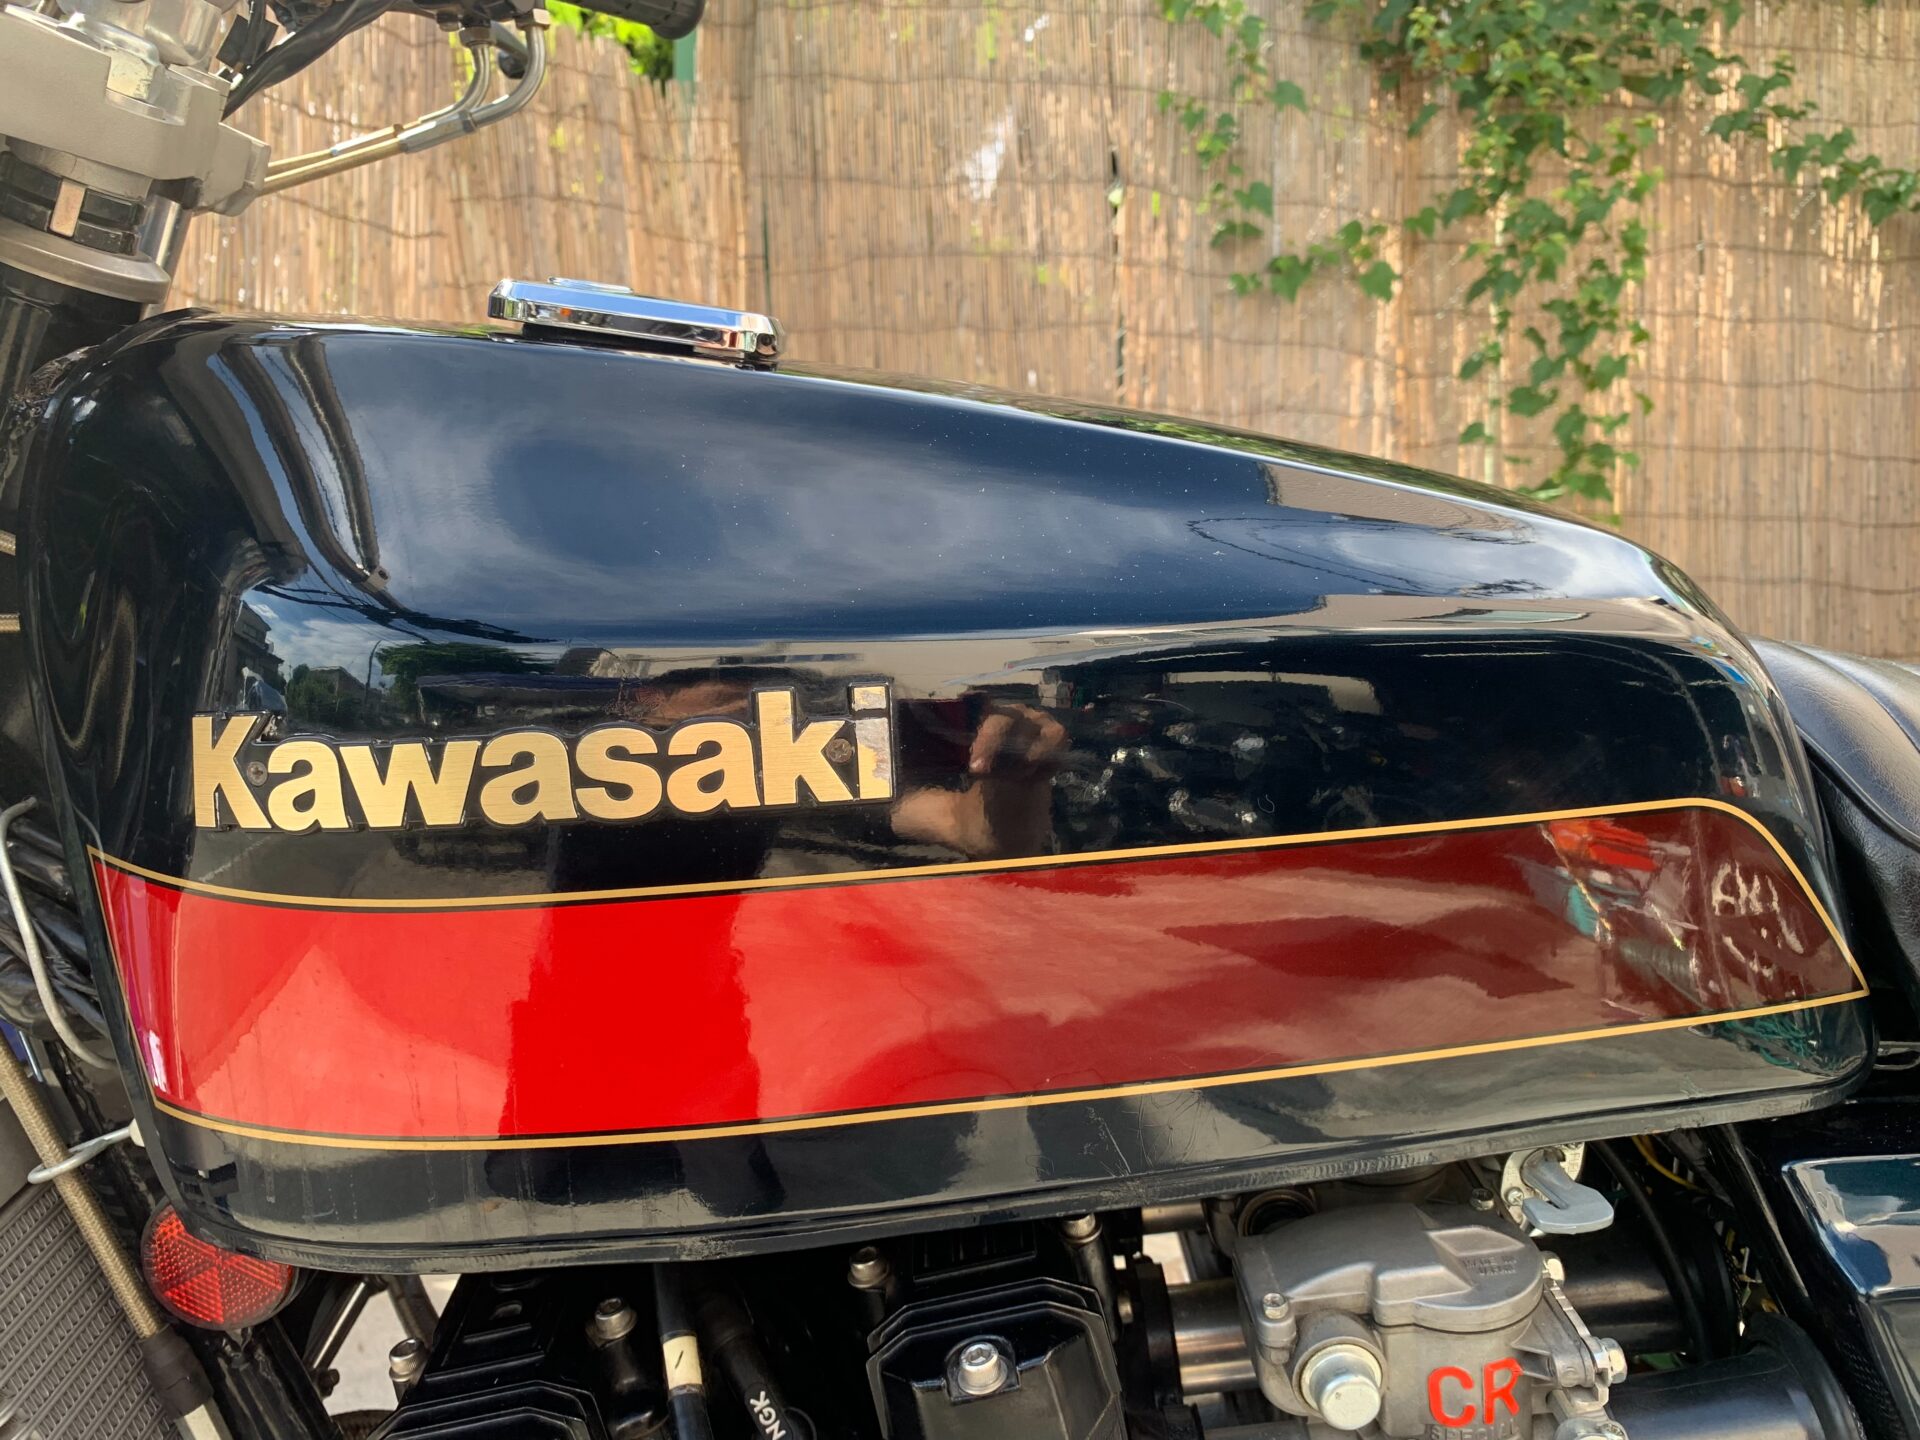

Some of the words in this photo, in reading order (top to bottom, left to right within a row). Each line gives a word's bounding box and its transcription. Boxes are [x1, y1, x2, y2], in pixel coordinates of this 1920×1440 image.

[191, 684, 893, 832] Kawasaki
[749, 1390, 787, 1440] NGK
[1427, 1357, 1523, 1428] CR
